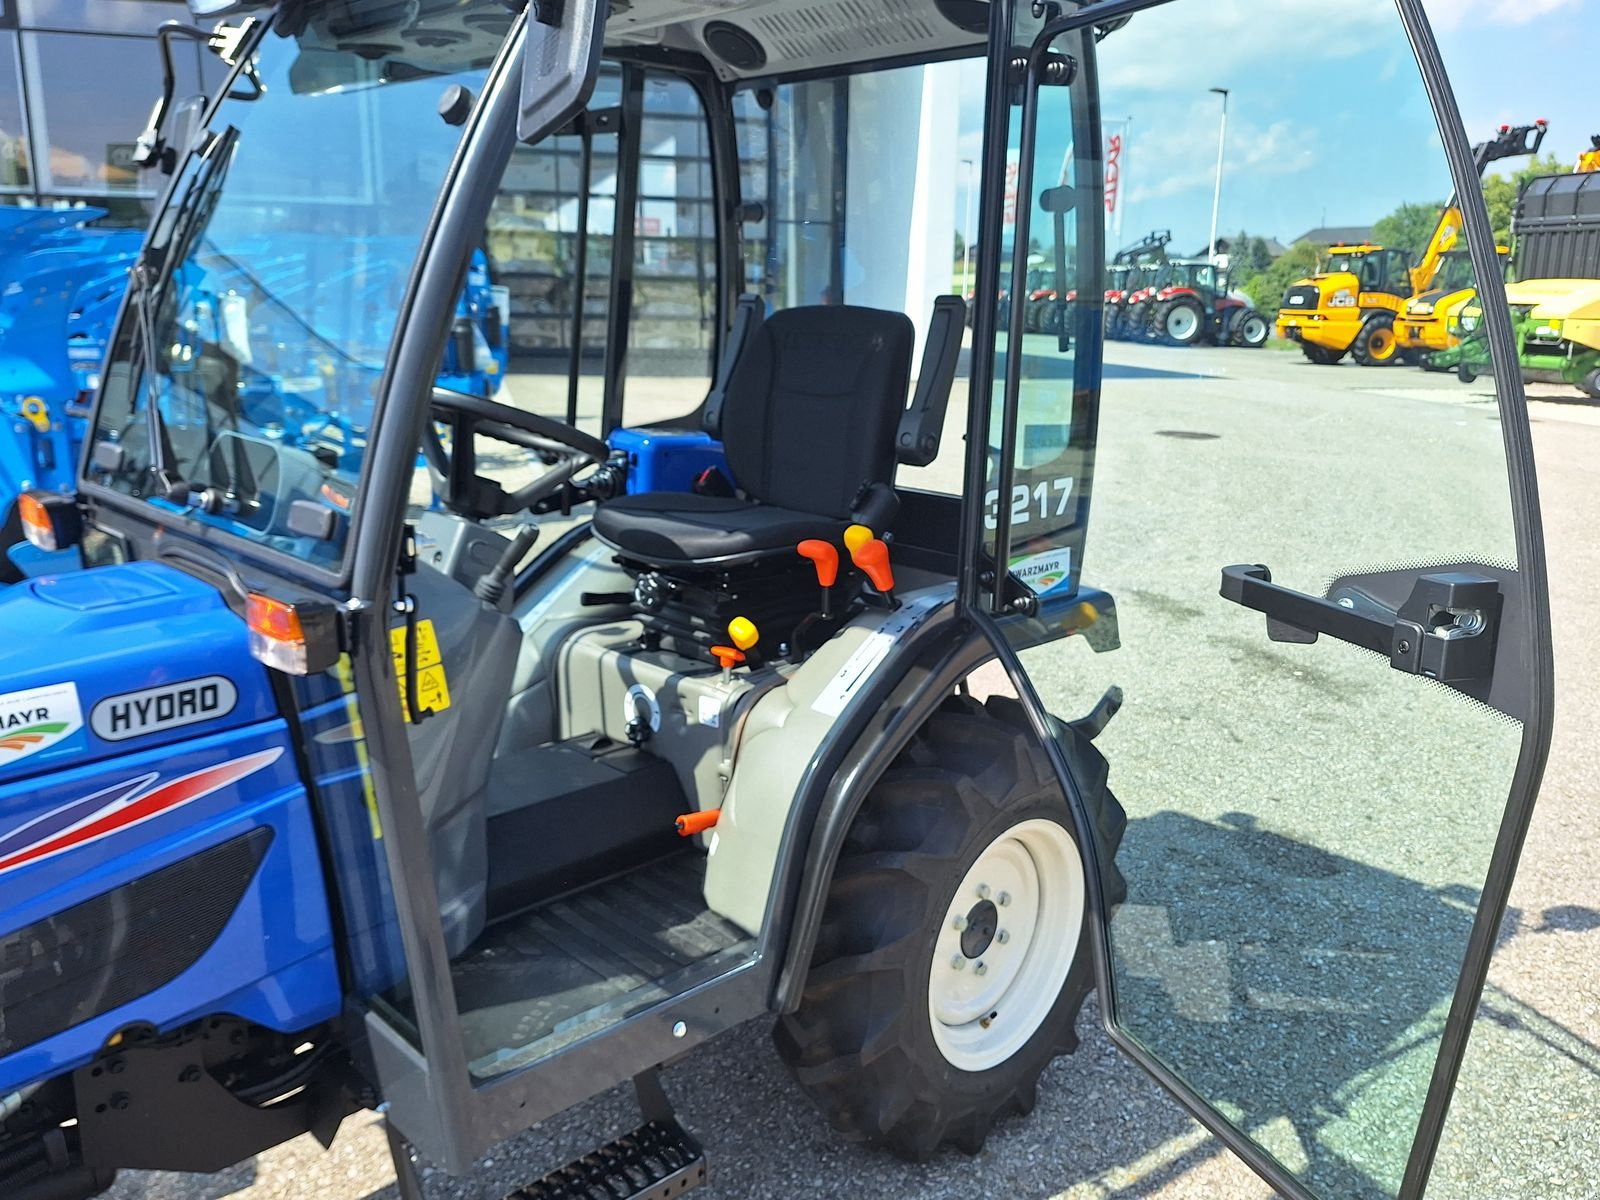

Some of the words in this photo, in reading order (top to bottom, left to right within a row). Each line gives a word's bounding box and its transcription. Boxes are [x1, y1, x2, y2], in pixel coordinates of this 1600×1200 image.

[1327, 295, 1355, 307] JCB
[983, 477, 1073, 530] 3217
[1013, 560, 1060, 578] WARZMAYR
[110, 684, 219, 732] HYDRO
